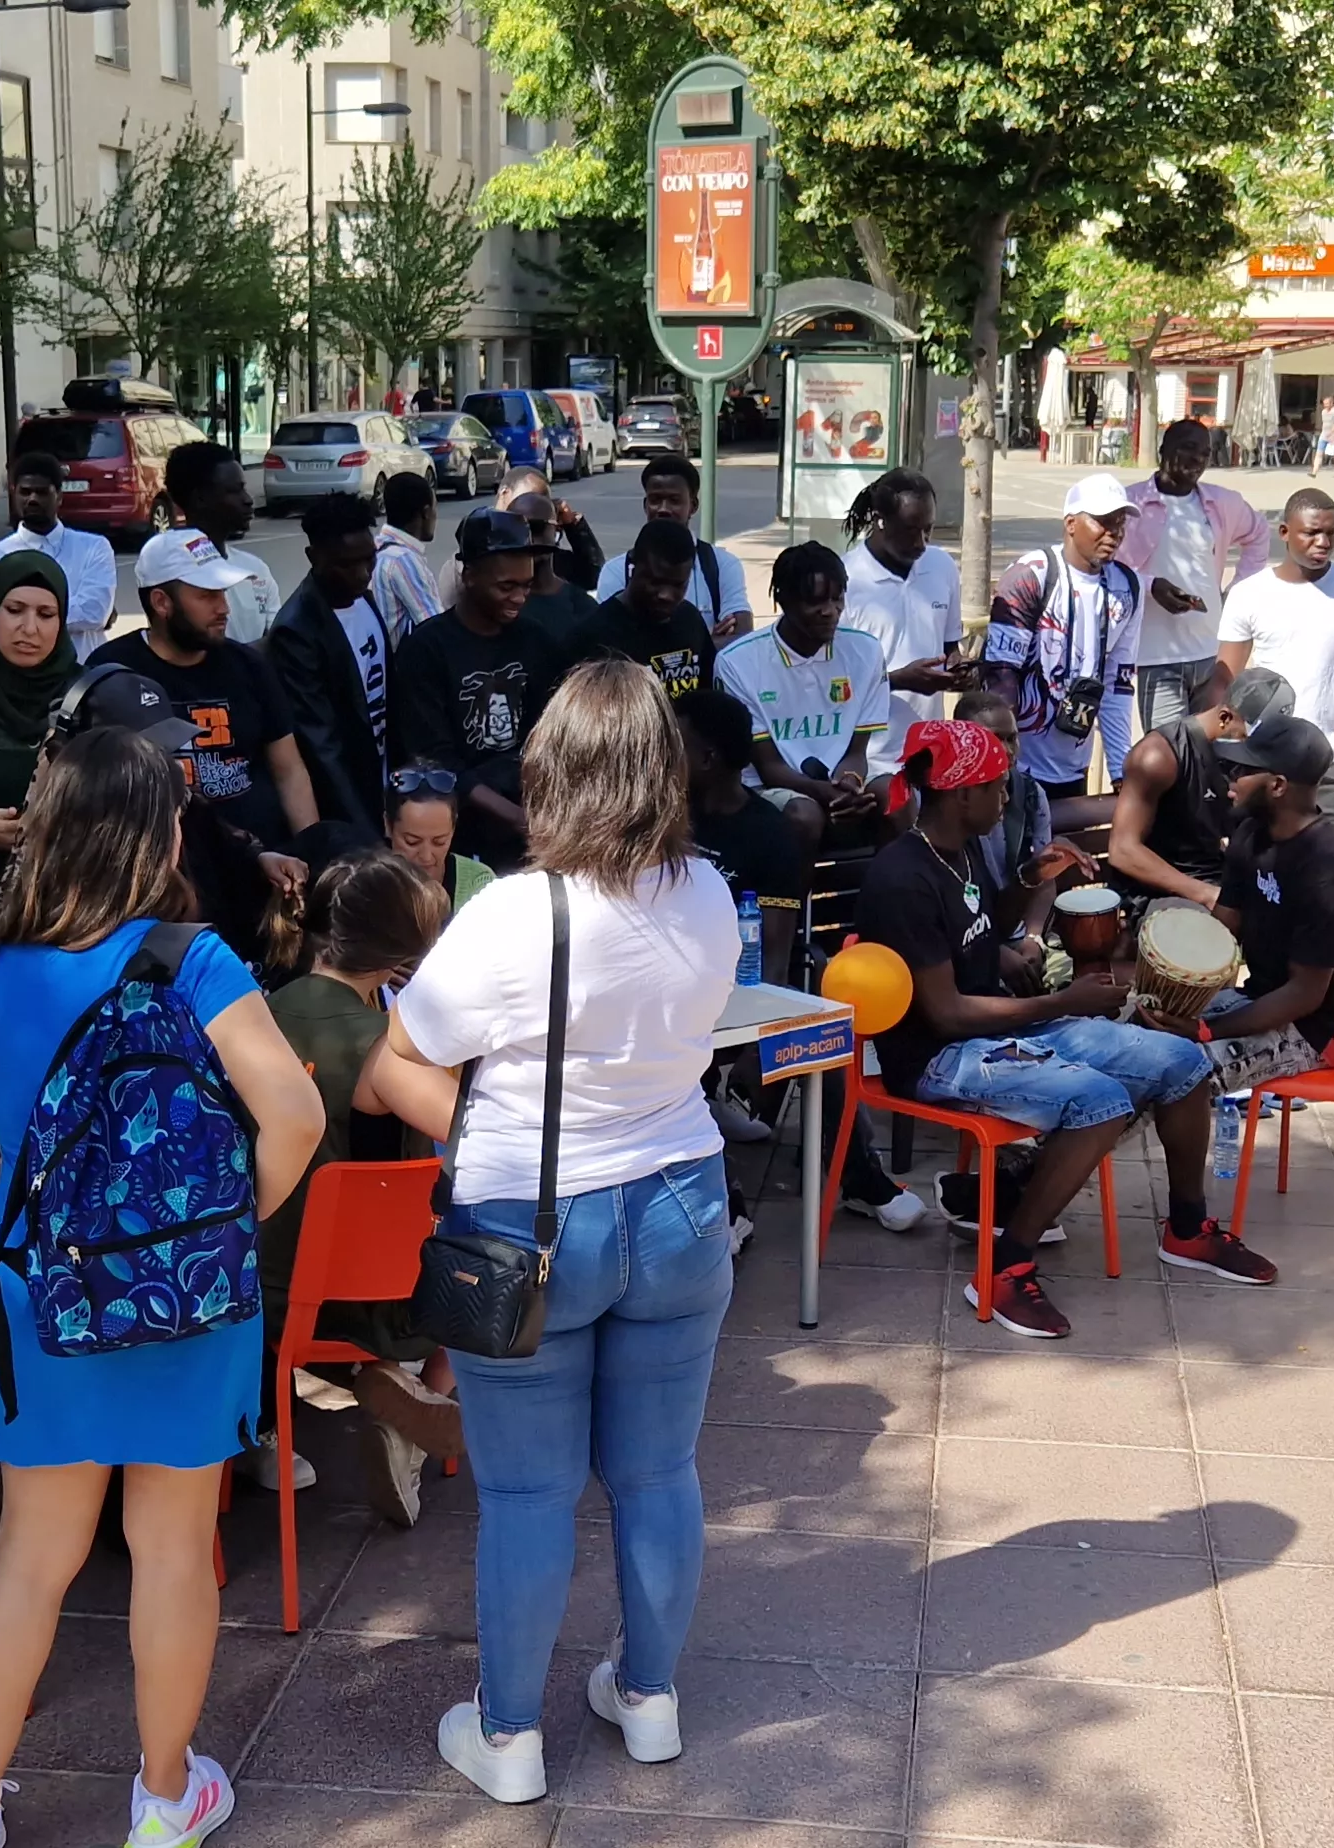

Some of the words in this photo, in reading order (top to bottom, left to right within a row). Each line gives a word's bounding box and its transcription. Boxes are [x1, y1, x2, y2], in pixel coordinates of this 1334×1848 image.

[661, 174, 693, 192] CON
[695, 173, 749, 190] TIEMPO
[796, 409, 885, 459] 112
[771, 712, 842, 741] MALI
[198, 752, 224, 767] ALL
[775, 1036, 845, 1064] apip-acam
